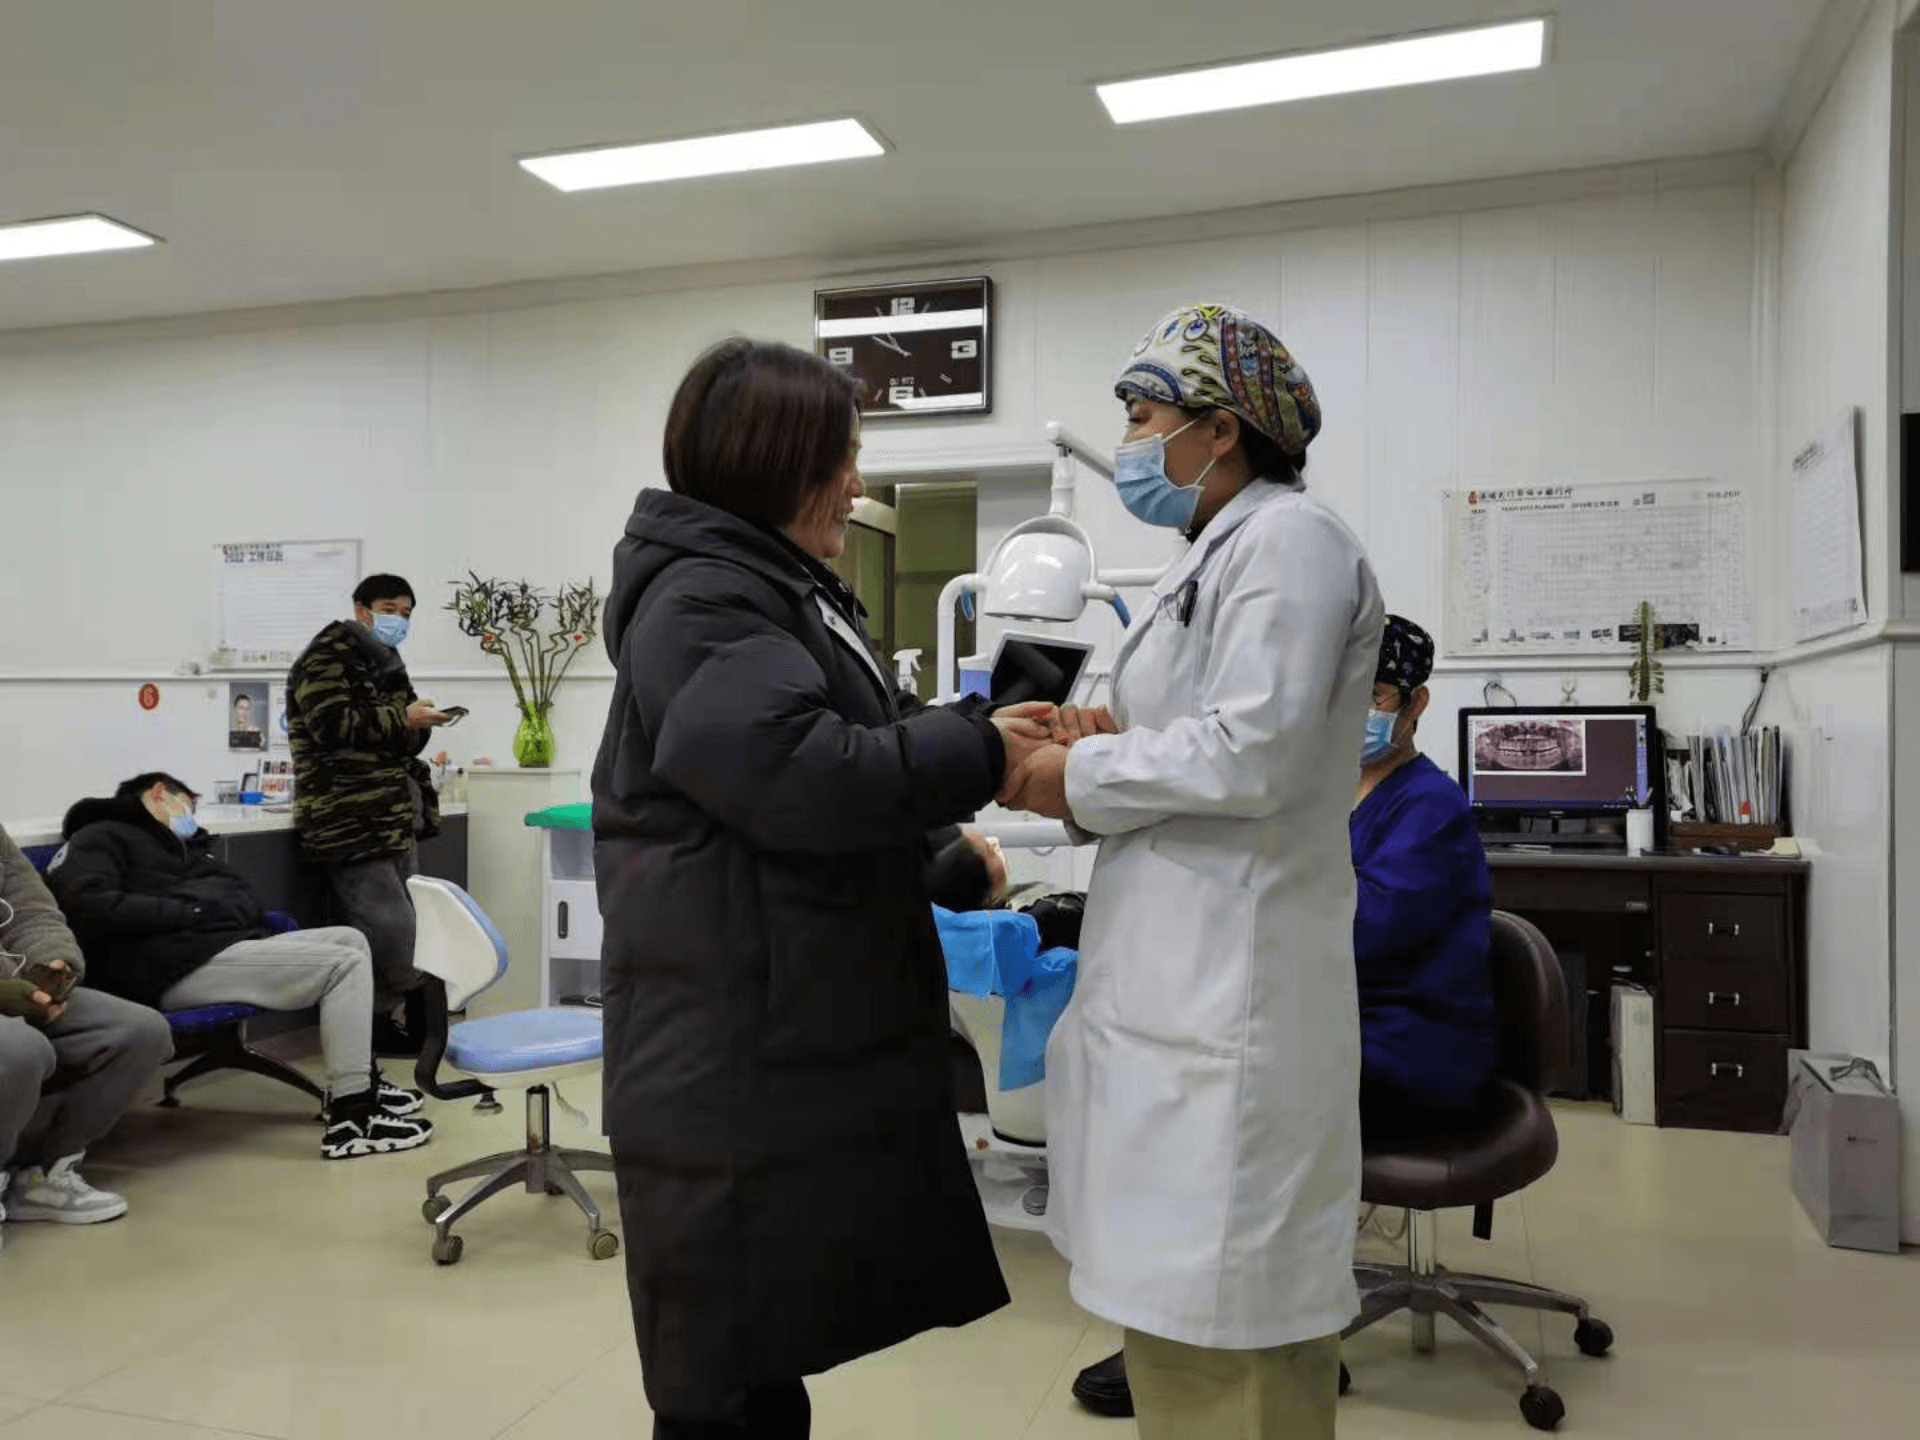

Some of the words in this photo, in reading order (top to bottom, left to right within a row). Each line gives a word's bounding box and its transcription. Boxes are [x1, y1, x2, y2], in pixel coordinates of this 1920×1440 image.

[891, 297, 915, 314] 12
[829, 347, 853, 365] 9
[951, 340, 977, 359] 3
[889, 385, 914, 404] 6
